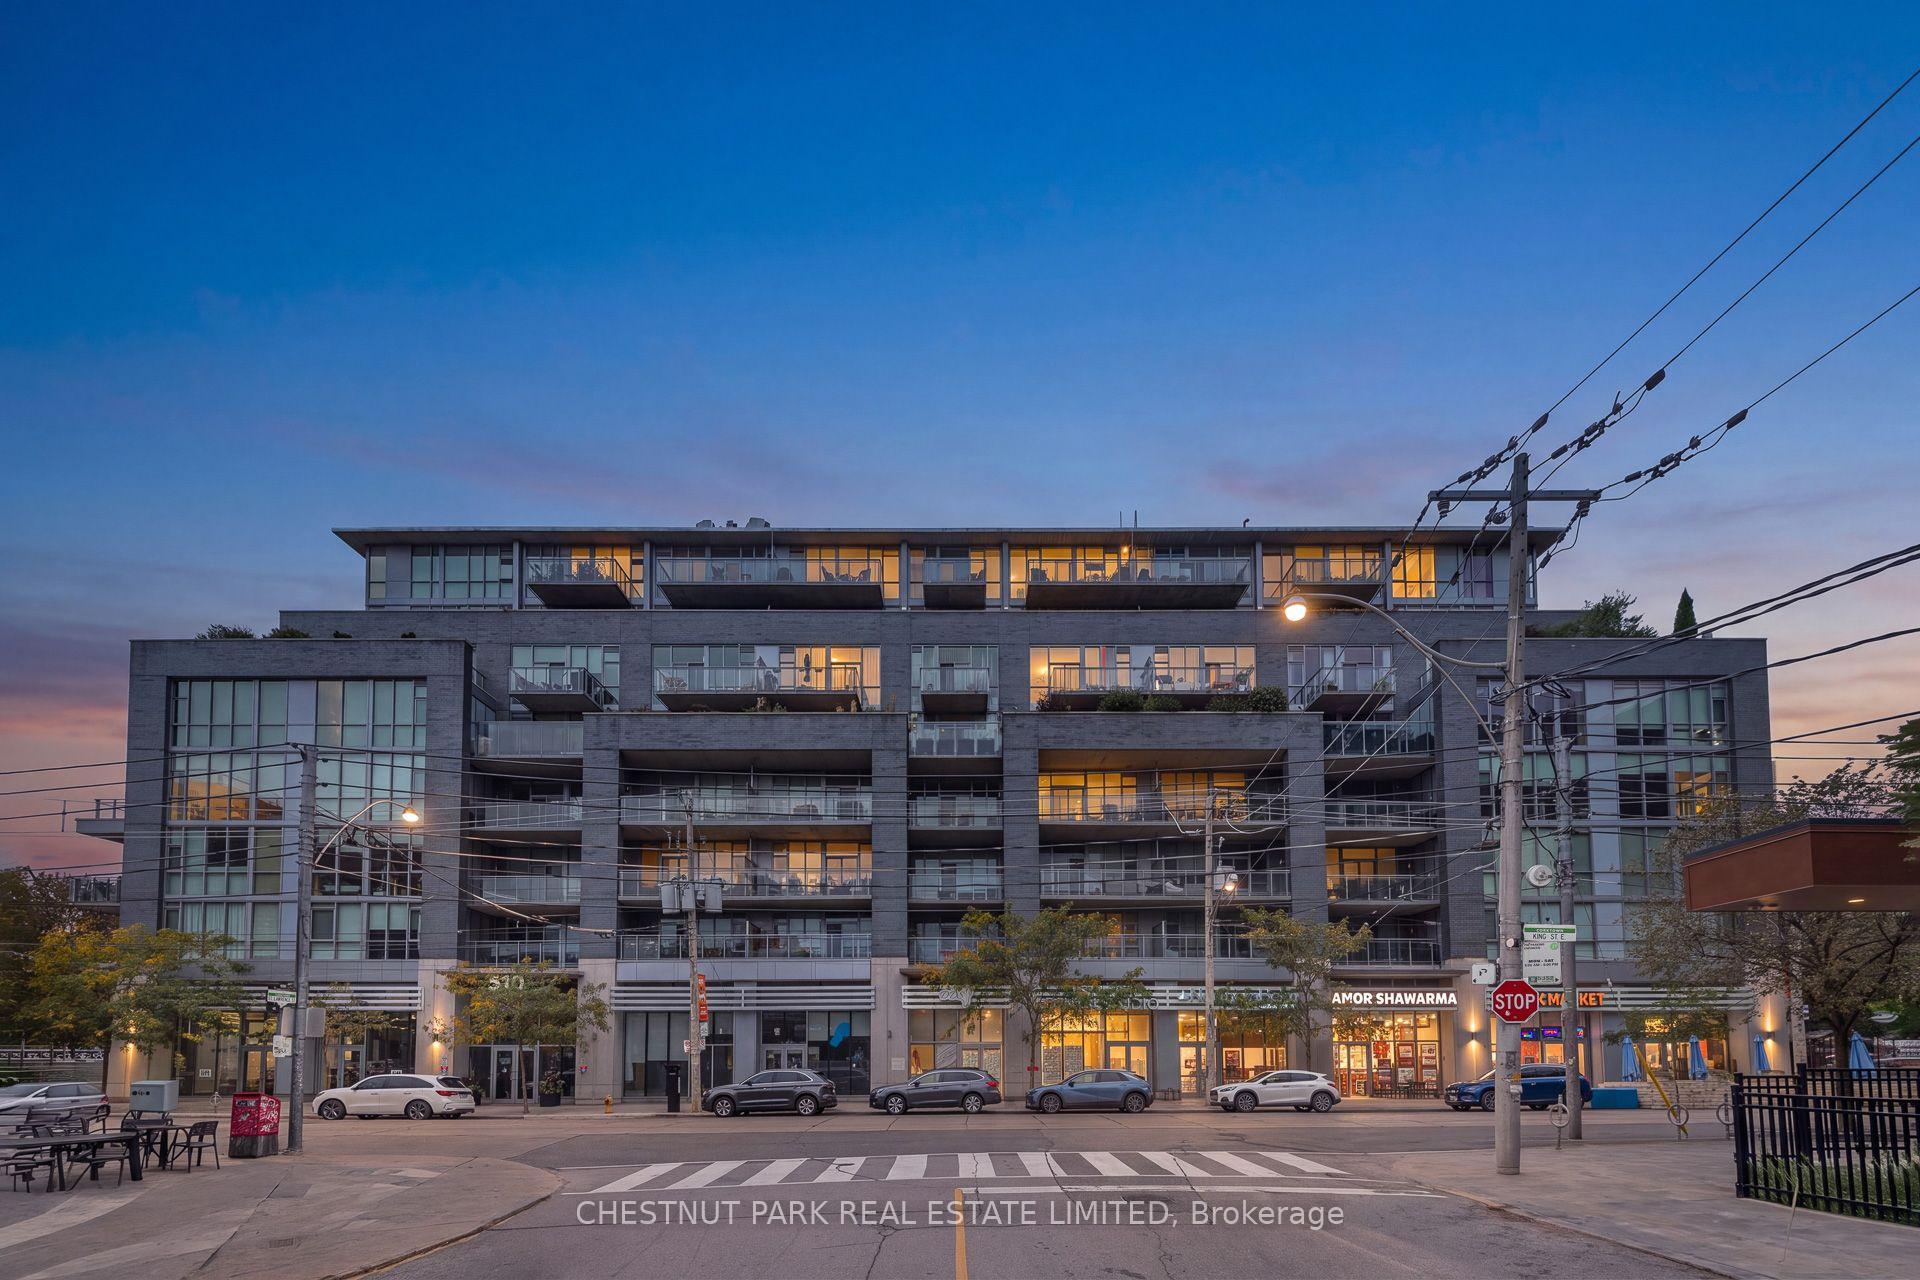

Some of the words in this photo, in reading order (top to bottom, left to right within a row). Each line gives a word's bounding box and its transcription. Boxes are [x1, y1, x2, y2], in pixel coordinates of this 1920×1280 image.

[1332, 992, 1373, 1005] AMOR
[1375, 992, 1458, 1005] SHAWARMA
[1495, 994, 1536, 1010] STOP
